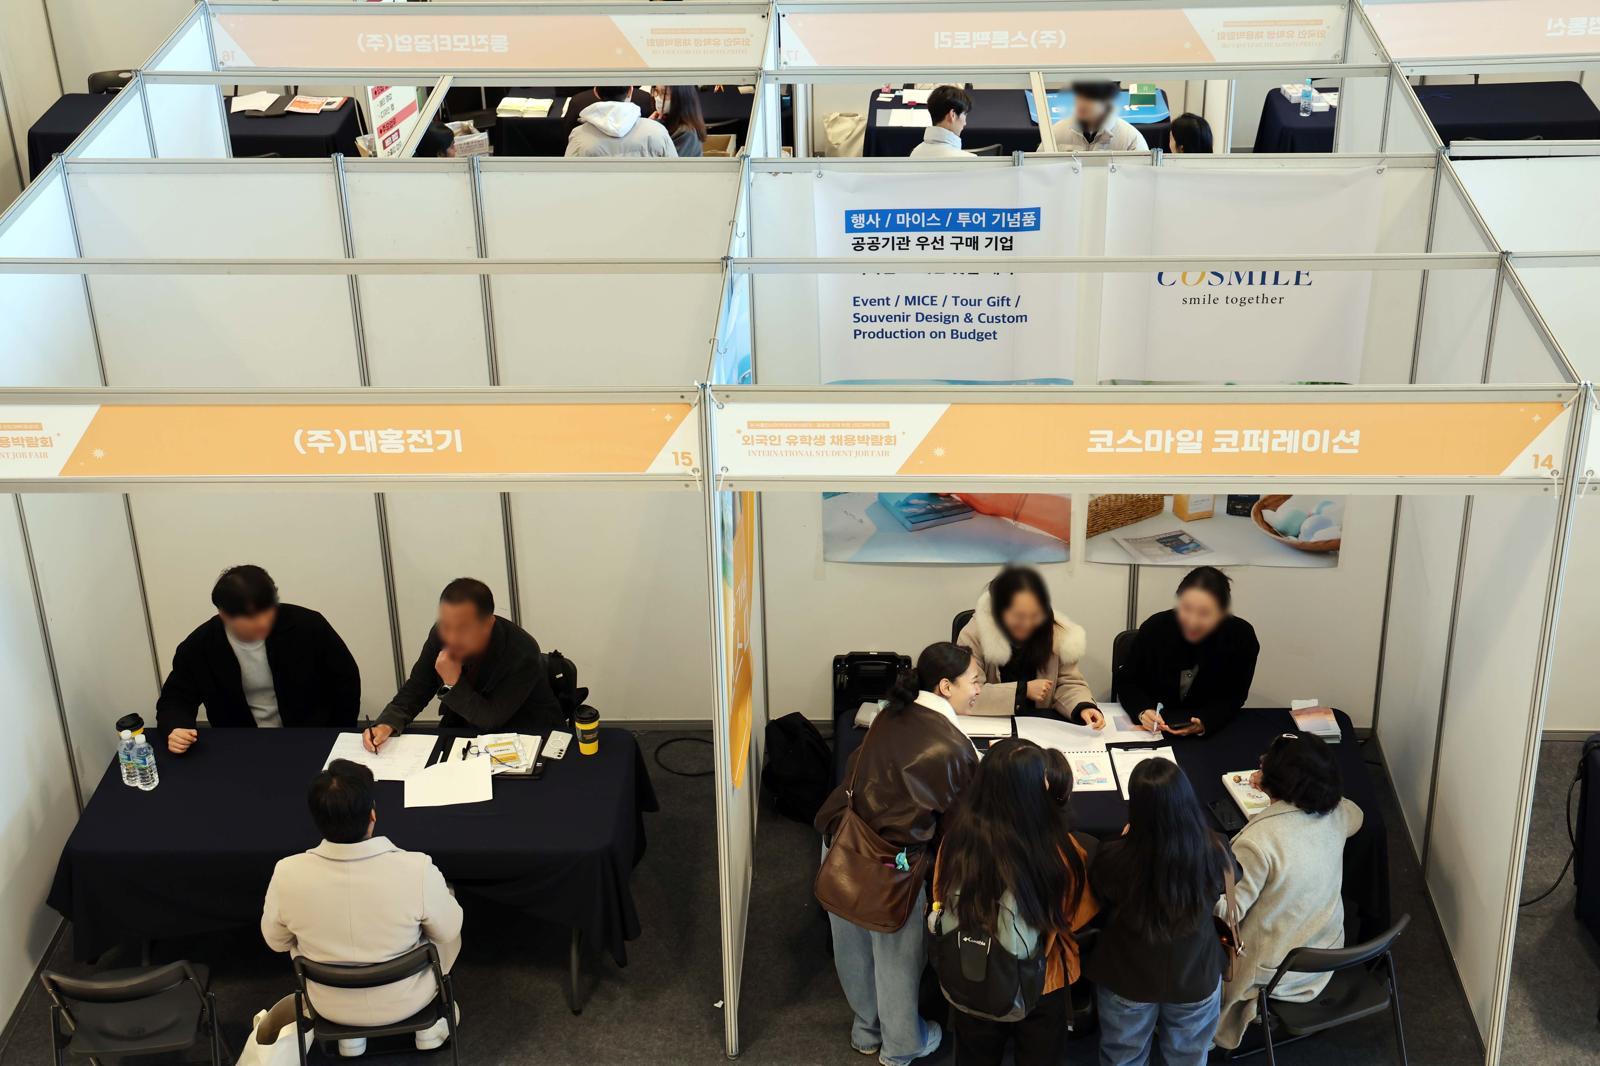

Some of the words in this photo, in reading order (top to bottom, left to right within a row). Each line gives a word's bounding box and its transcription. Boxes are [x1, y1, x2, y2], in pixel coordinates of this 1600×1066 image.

[850, 213, 881, 229] 행사
[885, 212, 892, 228] /
[896, 212, 941, 228] 마이스
[945, 212, 952, 228] /
[956, 212, 987, 228] 투어
[991, 211, 1037, 228] 기념품
[851, 236, 911, 252] 공공기관
[915, 235, 945, 251] 우선
[949, 235, 979, 251] 구매
[984, 235, 1014, 251] 기업
[852, 296, 891, 307] Event
[894, 295, 900, 308] /
[904, 295, 938, 306] MICE
[942, 295, 948, 308] /
[952, 296, 983, 307] Tour
[986, 295, 1011, 307] Gift
[1015, 295, 1021, 308] /
[1182, 293, 1219, 305] smile
[1225, 293, 1285, 307] together
[852, 312, 911, 323] Souvenir
[915, 312, 959, 325] Design
[963, 312, 974, 324] &
[977, 312, 1028, 324] Custom
[853, 328, 926, 340] Production
[929, 330, 946, 339] on
[950, 328, 998, 342] Budget
[293, 428, 463, 454] (주)대홍전기
[741, 434, 782, 447] 외국인
[785, 434, 826, 447] 유학생
[830, 434, 897, 447] 채용박람회
[1087, 429, 1203, 454] 코스마일
[1212, 429, 1360, 454] 코퍼레이션
[672, 451, 693, 466] 15
[1532, 454, 1554, 469] 14
